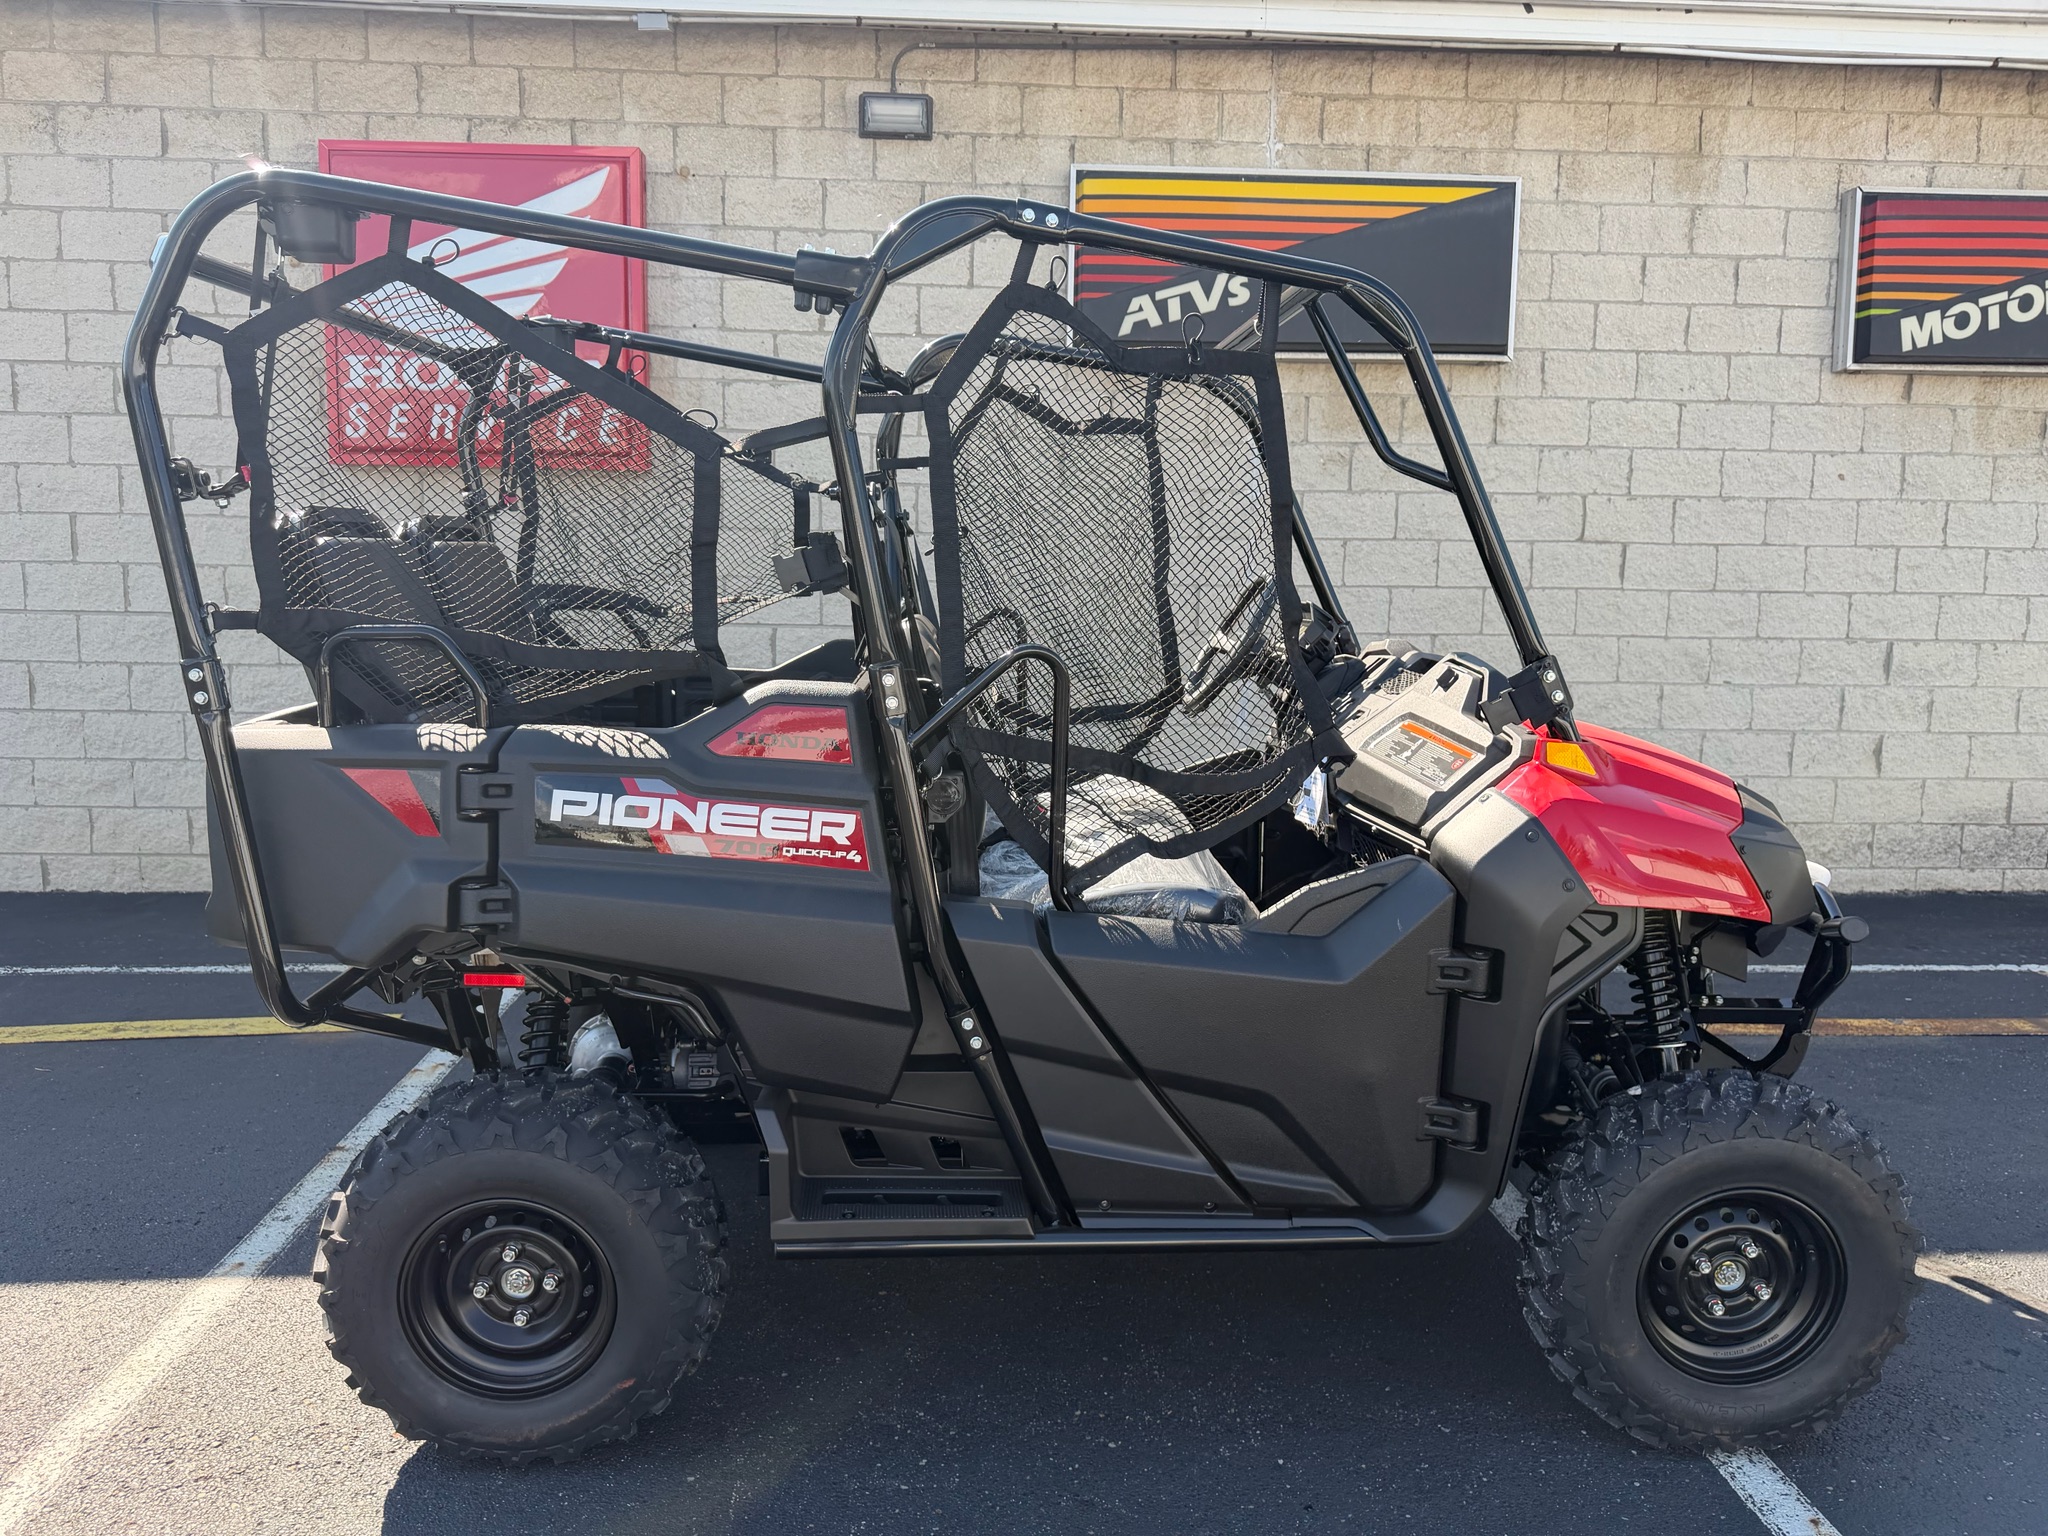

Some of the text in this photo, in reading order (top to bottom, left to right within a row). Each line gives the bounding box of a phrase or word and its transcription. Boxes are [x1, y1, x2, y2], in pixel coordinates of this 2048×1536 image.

[1900, 280, 2048, 353] MOTO
[344, 401, 621, 443] SERCE
[736, 731, 842, 751] HONDA
[550, 789, 856, 846] PIONEER
